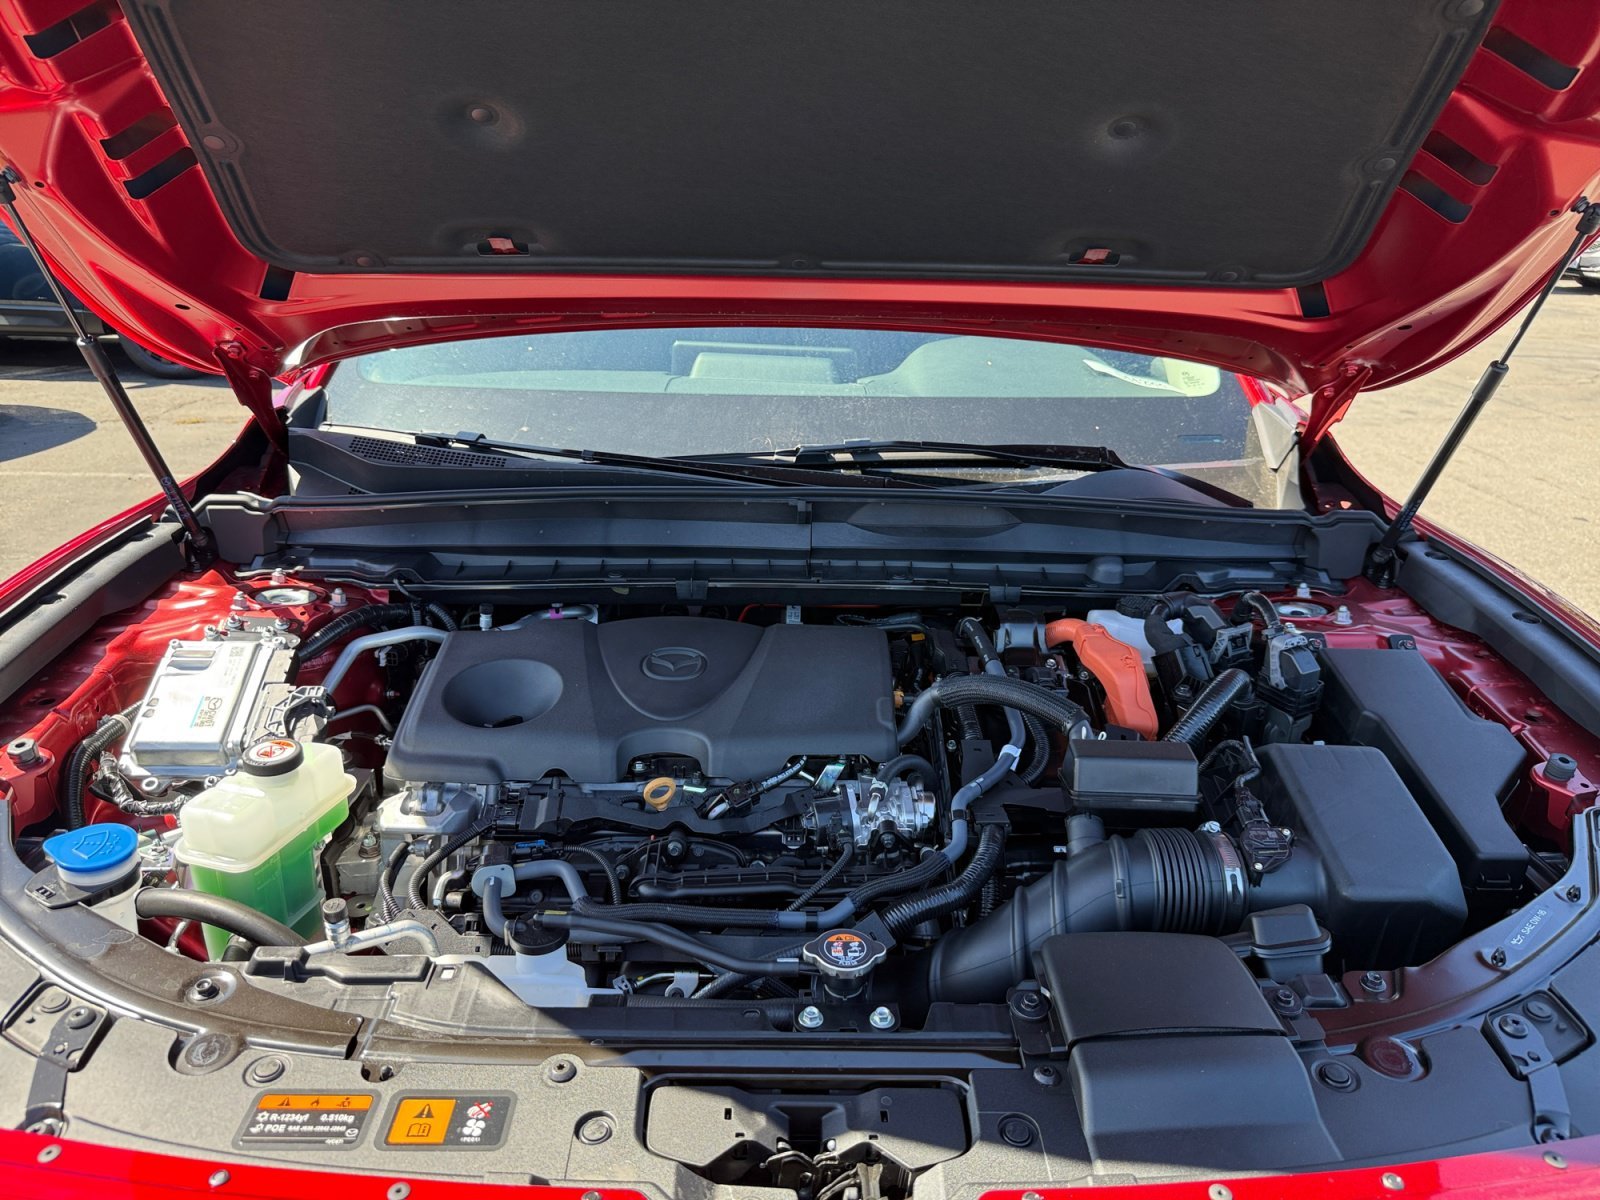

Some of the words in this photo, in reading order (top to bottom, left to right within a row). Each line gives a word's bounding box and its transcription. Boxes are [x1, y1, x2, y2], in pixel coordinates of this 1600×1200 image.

[1521, 922, 1535, 935] SAE
[269, 1113, 310, 1123] R-1234yf
[264, 1123, 286, 1133] POE
